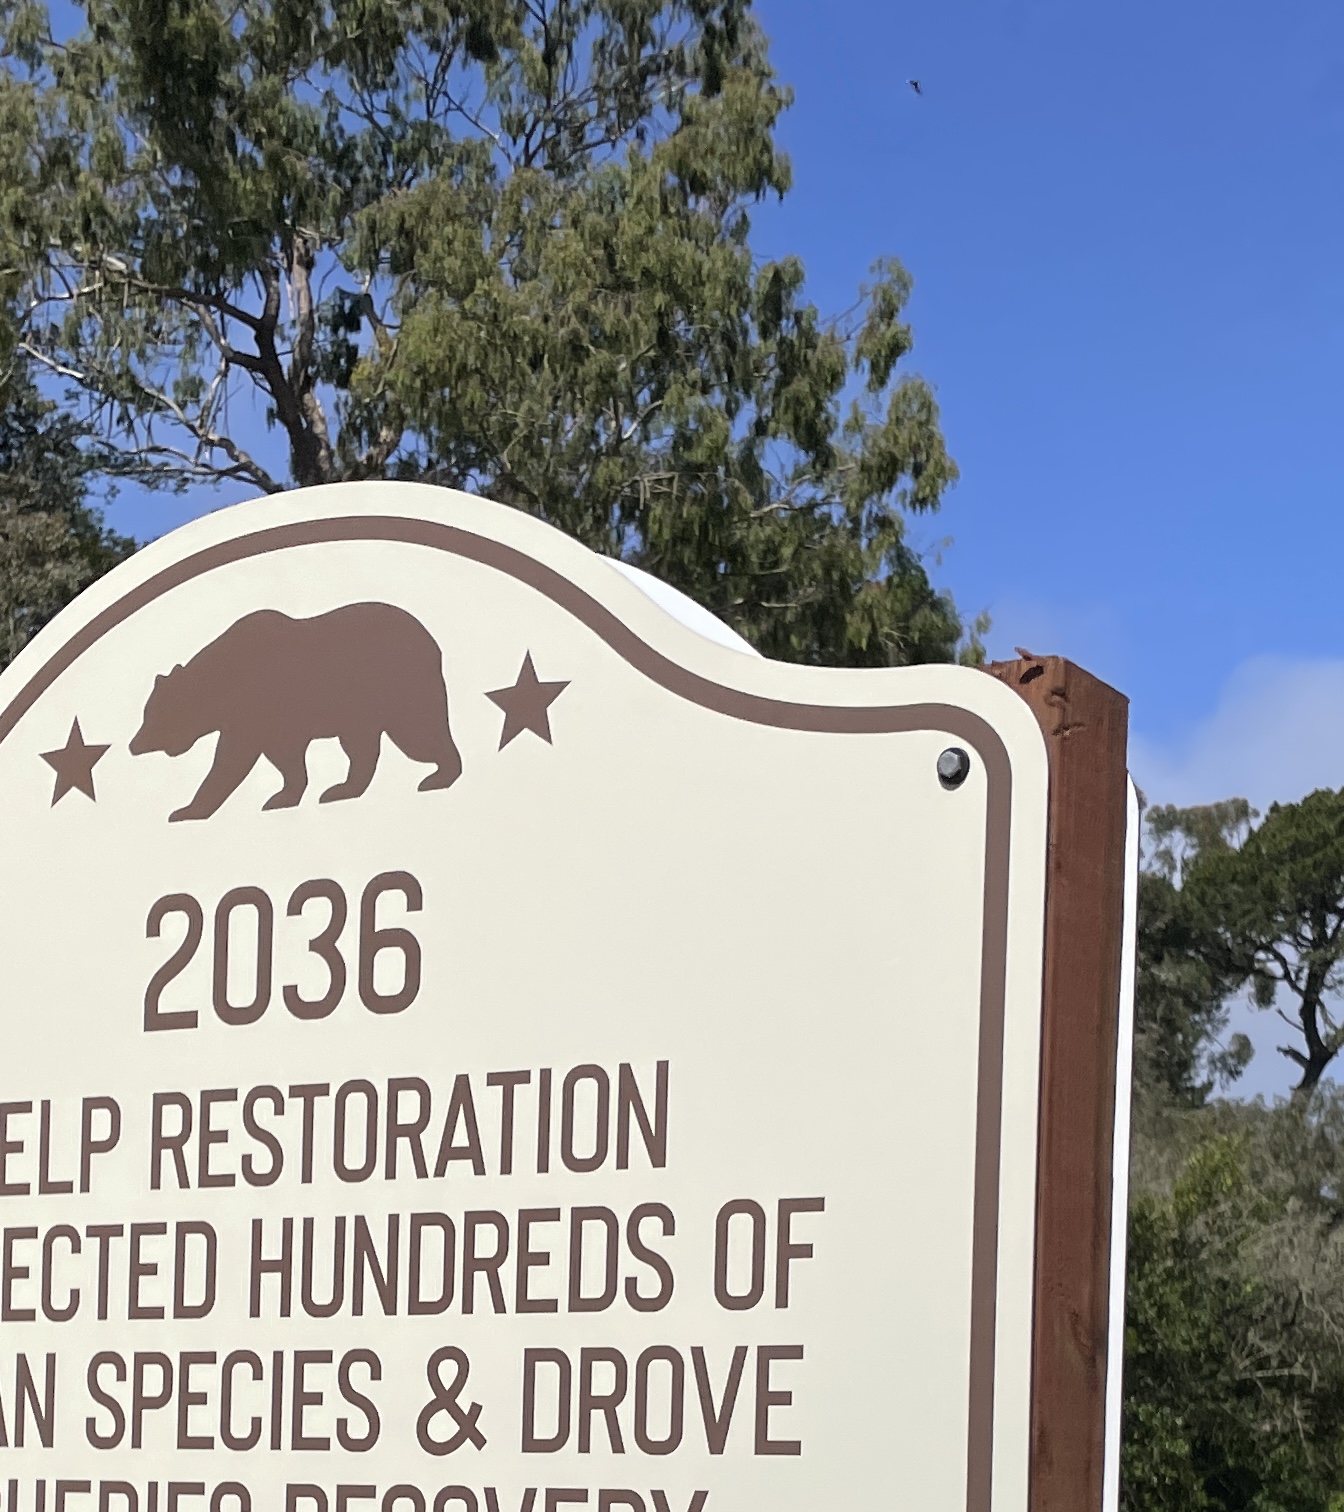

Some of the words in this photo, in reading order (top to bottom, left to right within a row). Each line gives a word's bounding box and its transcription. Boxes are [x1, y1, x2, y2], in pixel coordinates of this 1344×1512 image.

[143, 870, 423, 1033] 2036
[150, 1059, 670, 1191] RESTORATION
[249, 1202, 676, 1319] HUNDREDS
[713, 1196, 826, 1311] OF
[85, 1348, 382, 1453] SPECIES
[416, 1345, 488, 1457] &
[521, 1344, 805, 1456] DROVE
